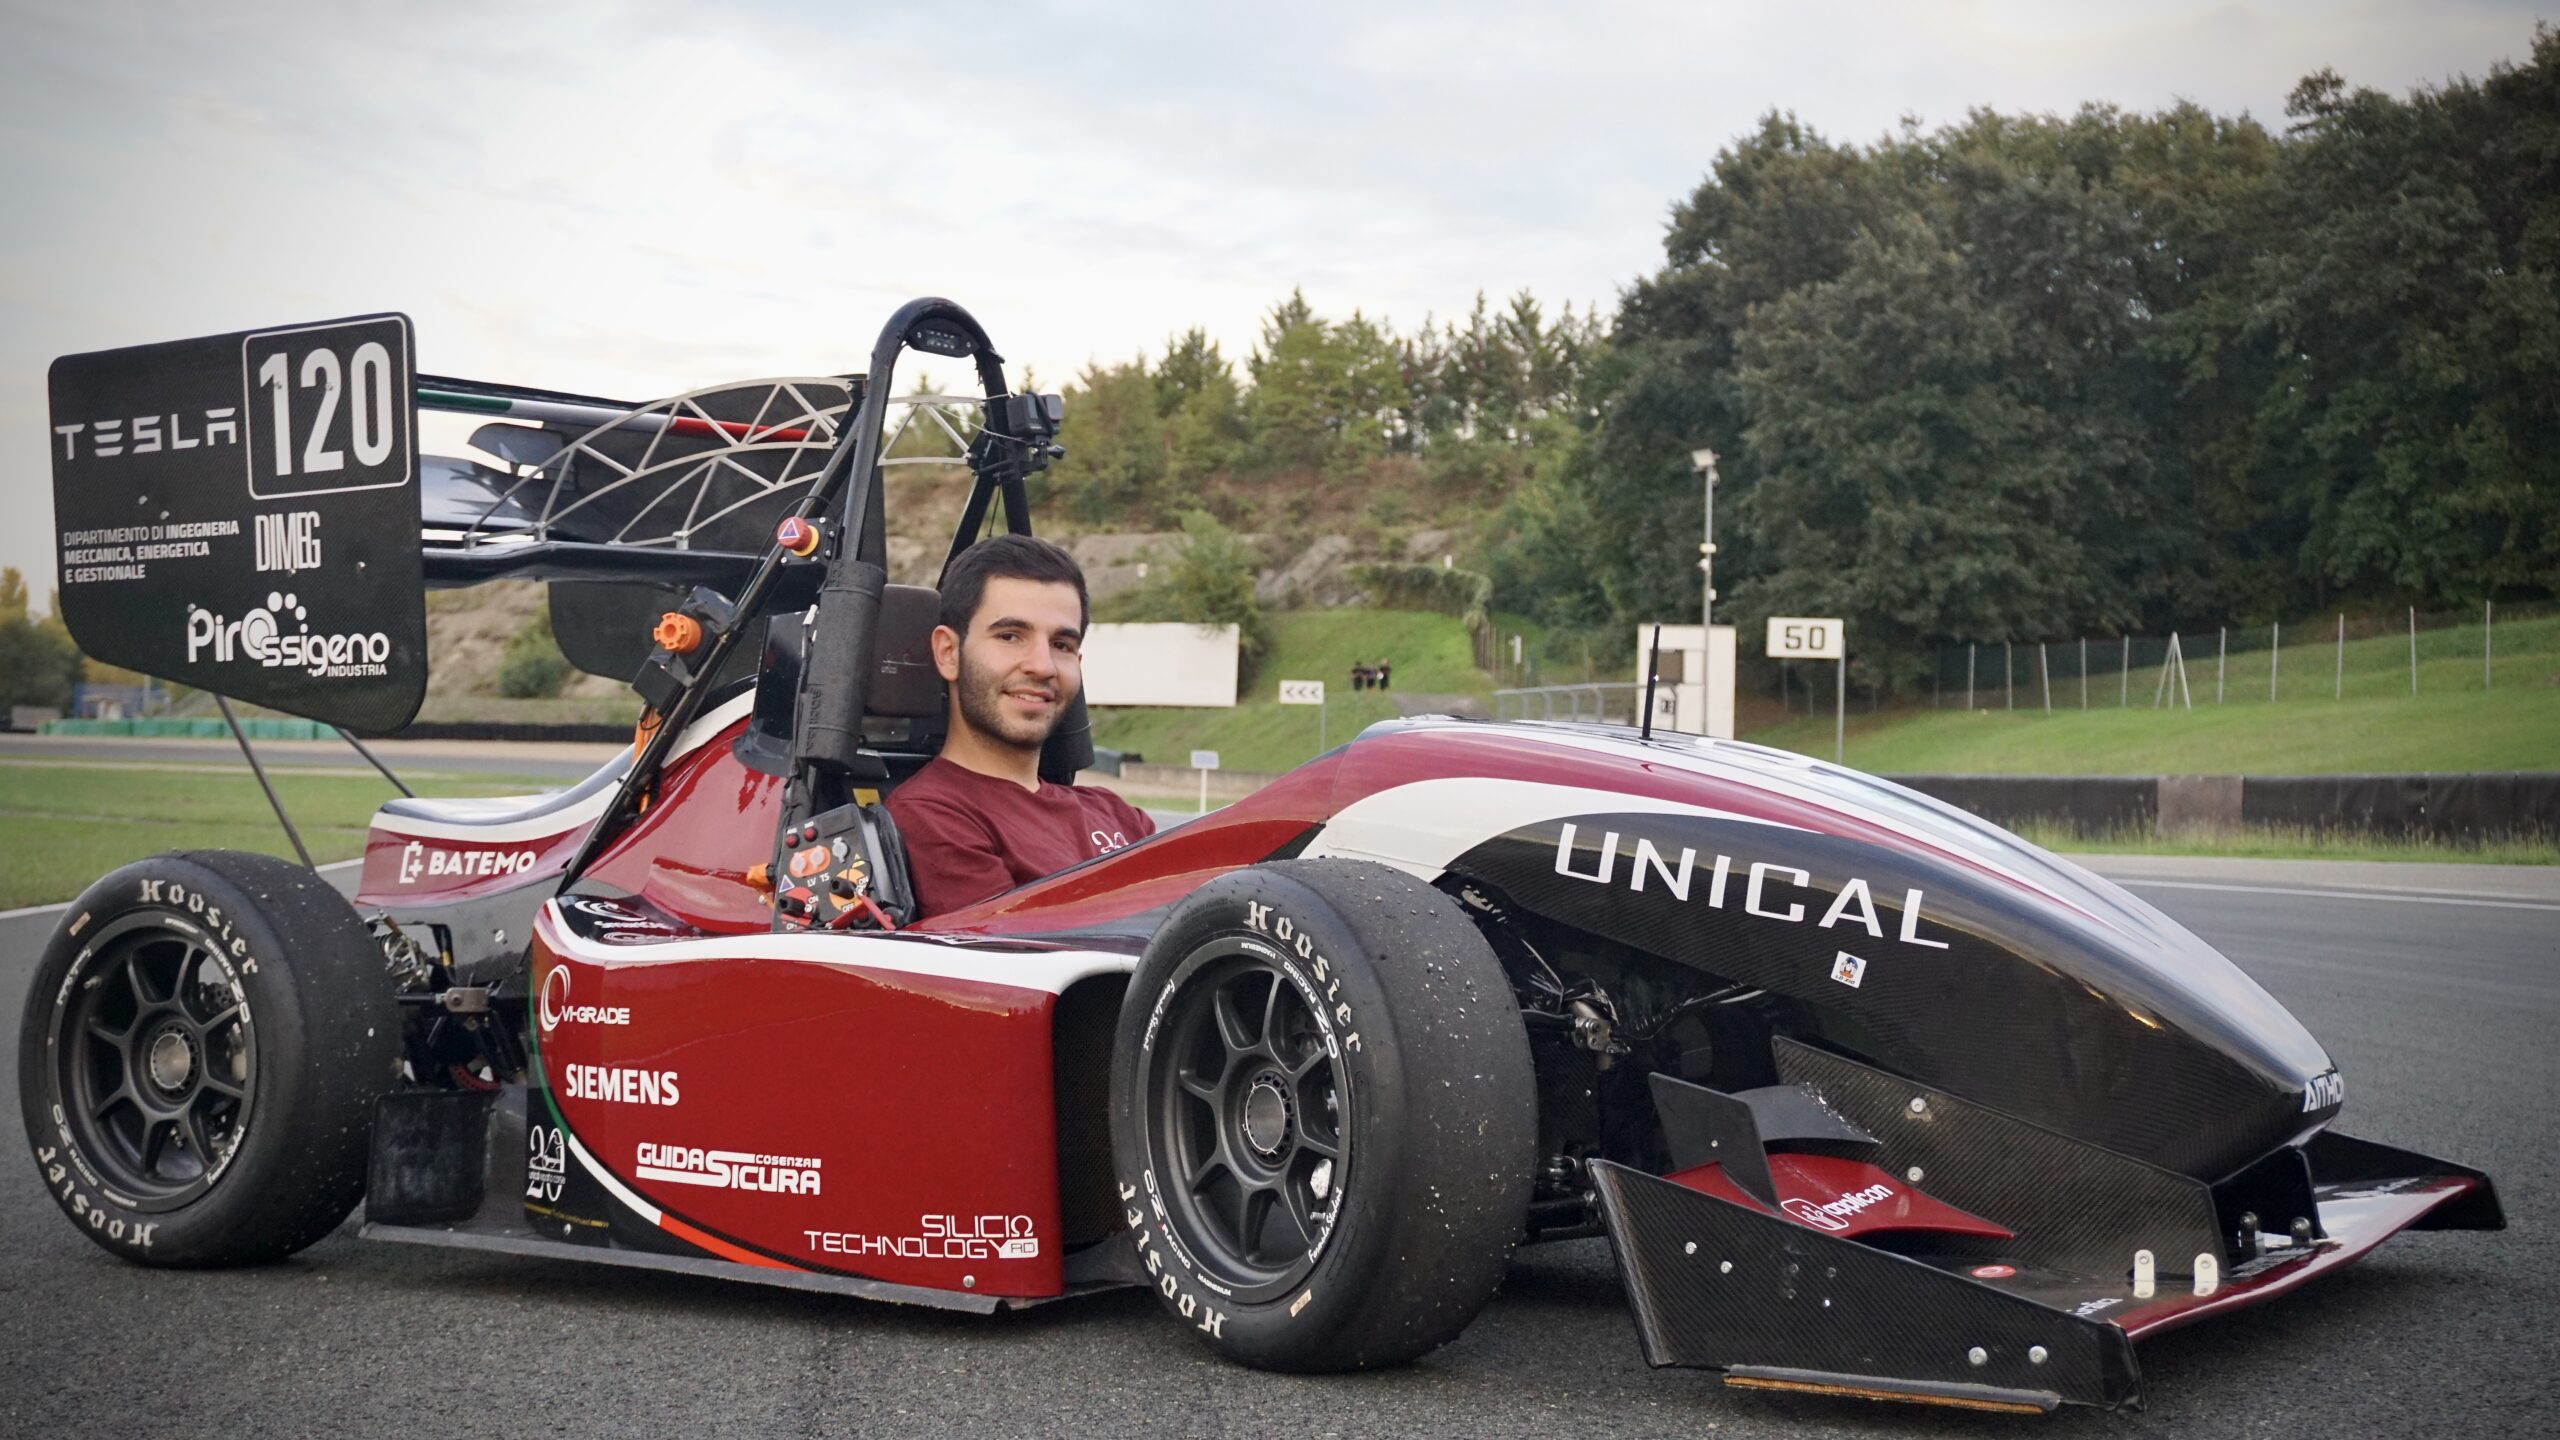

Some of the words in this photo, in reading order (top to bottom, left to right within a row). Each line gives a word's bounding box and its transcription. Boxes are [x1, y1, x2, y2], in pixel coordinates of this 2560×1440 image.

[259, 341, 393, 477] 120
[54, 407, 238, 461] TESLA
[64, 526, 150, 547] DIPARTIMENTO
[151, 525, 164, 541] DI
[165, 520, 240, 539] INGEGNERIA
[255, 511, 321, 572] DIMEG
[64, 547, 135, 565] MECCANICA,
[136, 541, 210, 561] ENERGETICA
[65, 569, 74, 583] E
[75, 564, 146, 583] GESTIONALE
[1785, 625, 1825, 650] 50
[327, 664, 387, 677] INDUSTRIA
[428, 850, 536, 876] BATEMO
[807, 877, 817, 888] LV
[819, 872, 830, 883] TS
[1555, 822, 1949, 949] UNICAL
[137, 879, 258, 974] Hoosier
[1244, 900, 1361, 1053] Hoosier
[1283, 961, 1316, 1004] RACING
[561, 1005, 630, 1025] VI-GRADE
[566, 1063, 680, 1106] SIEMENS
[637, 1142, 704, 1171] GUIDA
[756, 1154, 811, 1168] COSENZA
[38, 1147, 159, 1247] Hoosier
[1822, 1184, 1894, 1216] applicon
[804, 1230, 1003, 1259] TECHNOLOGY
[1119, 1182, 1229, 1339] Hoosier
[1162, 1223, 1191, 1269] RACING
